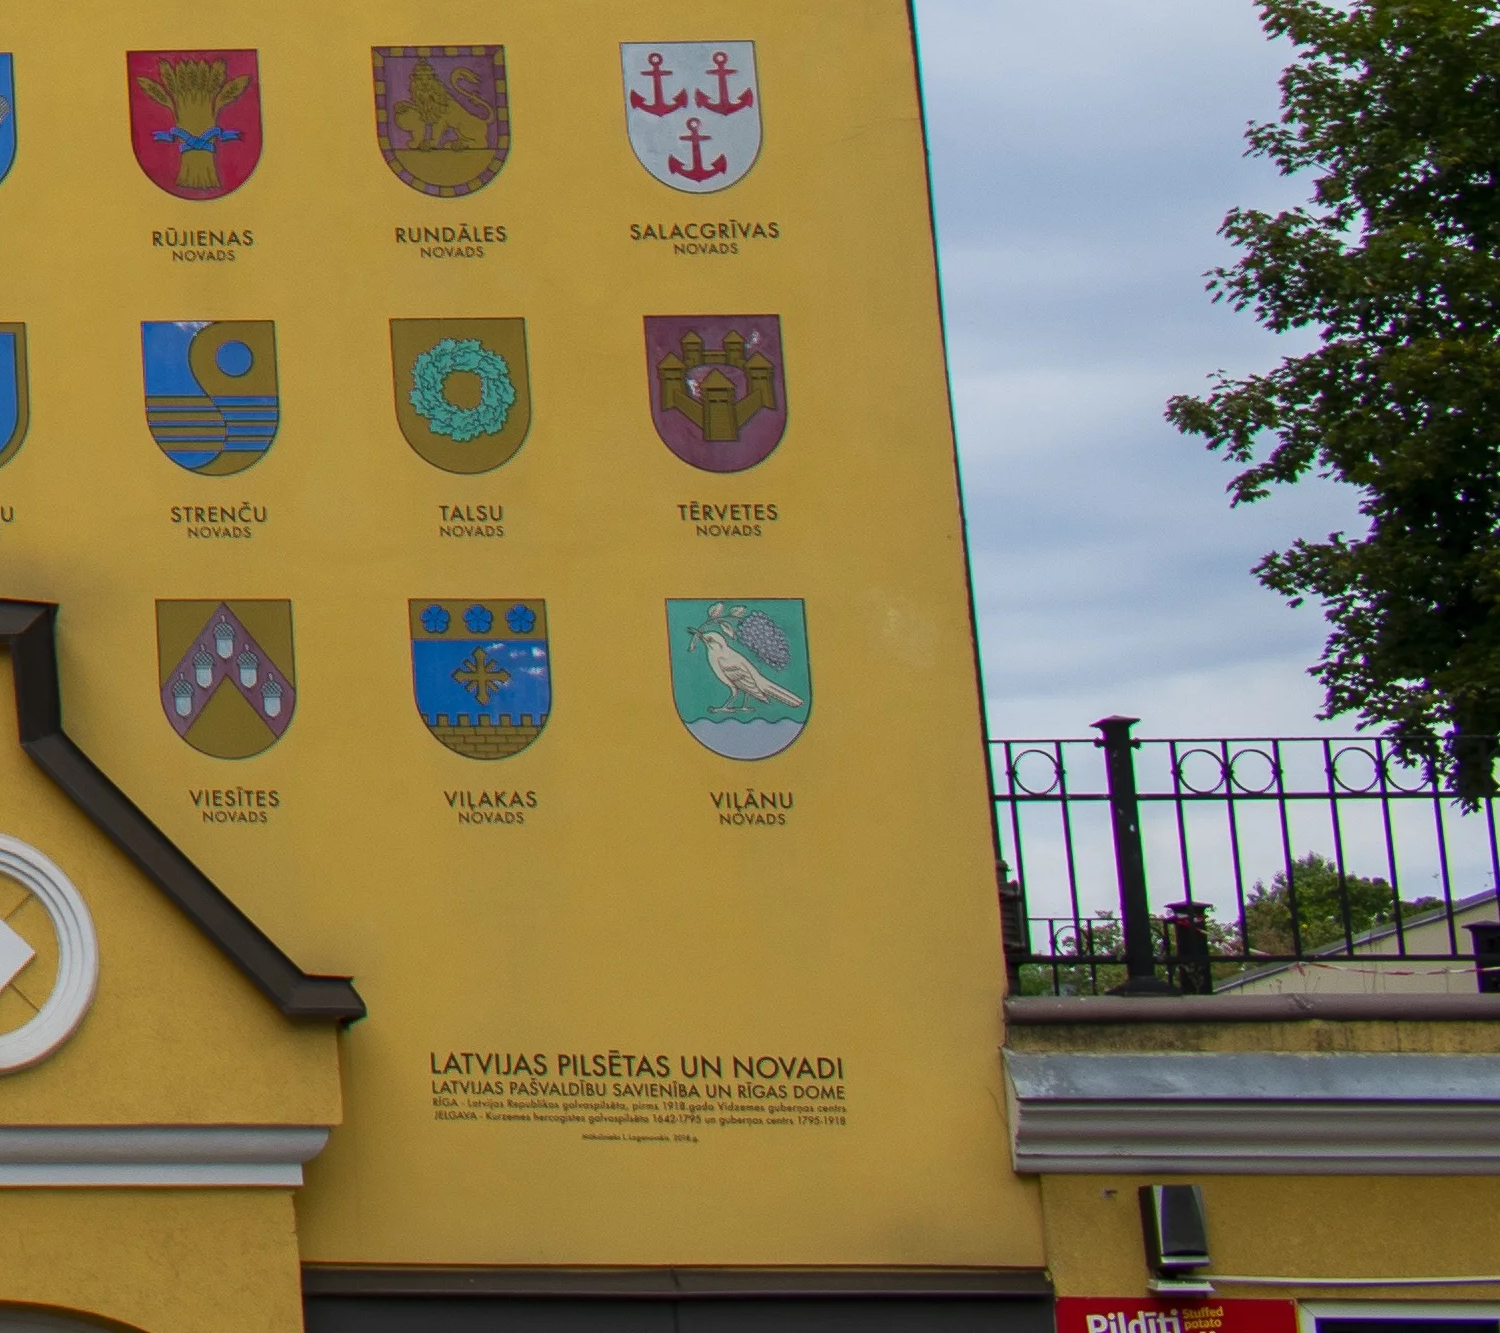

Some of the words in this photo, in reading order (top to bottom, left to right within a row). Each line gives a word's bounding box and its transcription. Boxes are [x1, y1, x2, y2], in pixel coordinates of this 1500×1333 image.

[152, 227, 254, 247] RŪJIENAS
[394, 222, 508, 244] RUNDĀLES
[630, 218, 780, 241] SALACGRĪVAS
[170, 501, 268, 524] STRENČU
[438, 504, 504, 523] TALSU
[677, 500, 778, 522] TĒRVETES
[188, 785, 280, 809] VIESĪTES
[443, 790, 538, 814] VIĻAKAS
[709, 787, 794, 816] VIĻĀNU
[430, 1051, 548, 1075] LATVIJAS
[557, 1049, 671, 1077] PILSĒTAS
[680, 1055, 722, 1079] UN
[732, 1056, 844, 1080] NOVADI
[431, 1080, 504, 1096] LATVIJAS
[509, 1078, 607, 1097] PAŠVALDĪBU
[612, 1081, 701, 1099] SAVIENĪBA
[706, 1085, 732, 1099] UN
[737, 1082, 788, 1099] RĪGAS
[793, 1085, 846, 1101] DOME
[1182, 1306, 1224, 1318] Stuffed
[1184, 1317, 1222, 1330] potato
